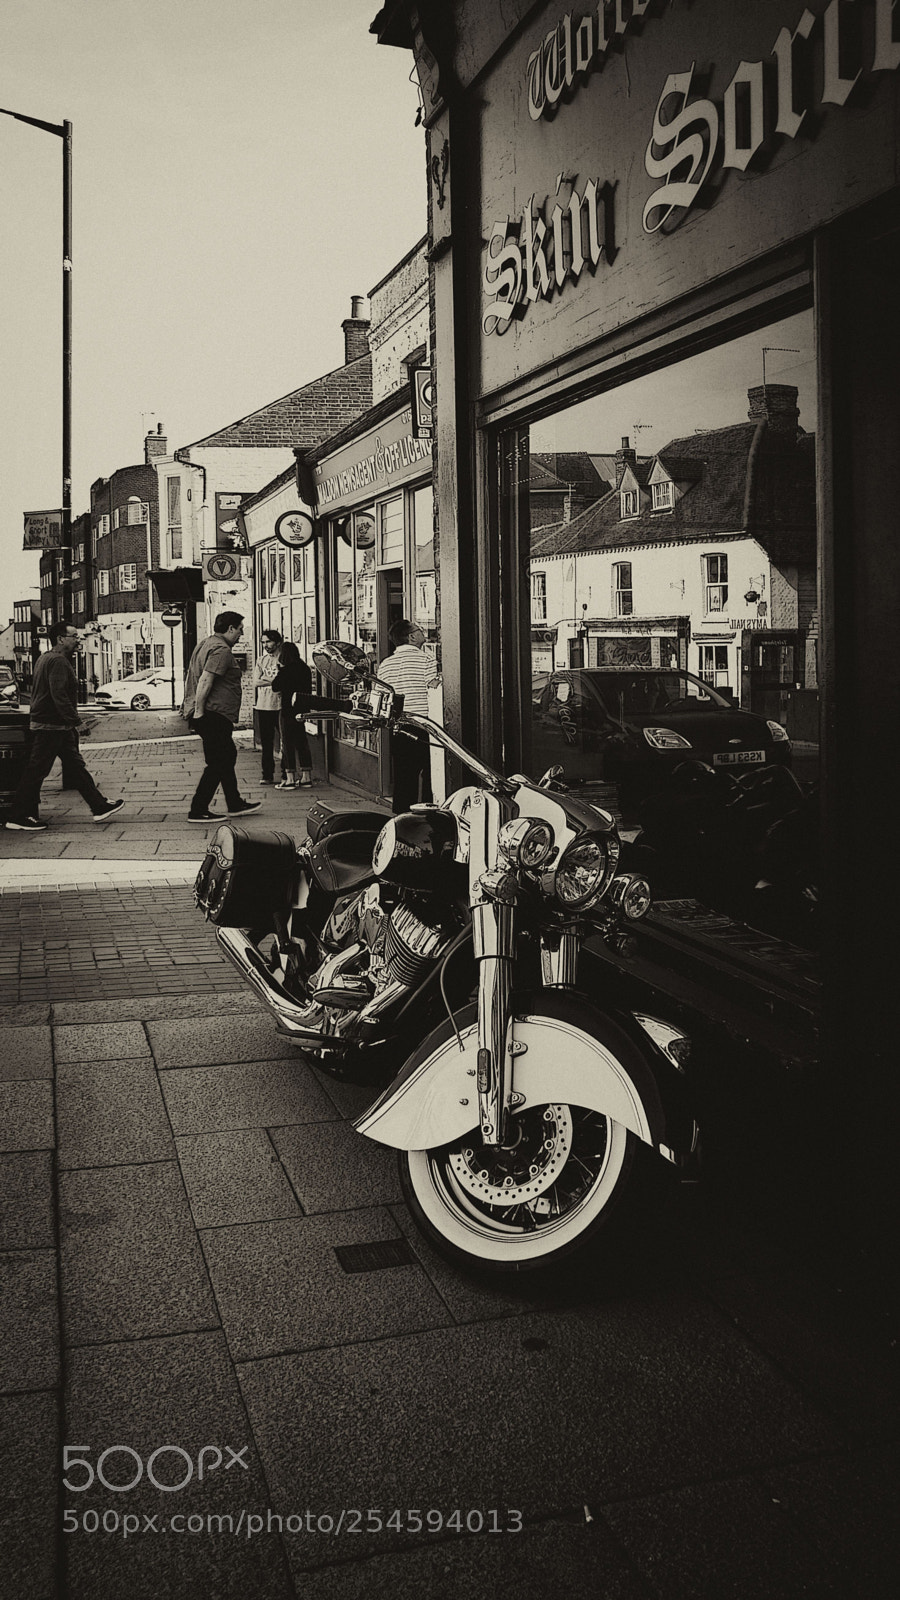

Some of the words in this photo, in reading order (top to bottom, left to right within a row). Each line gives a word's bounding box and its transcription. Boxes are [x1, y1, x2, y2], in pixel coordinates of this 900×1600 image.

[481, 171, 604, 337] Skin
[339, 456, 378, 497] NEWSAGENT
[375, 436, 386, 480] &
[384, 442, 401, 474] OFF
